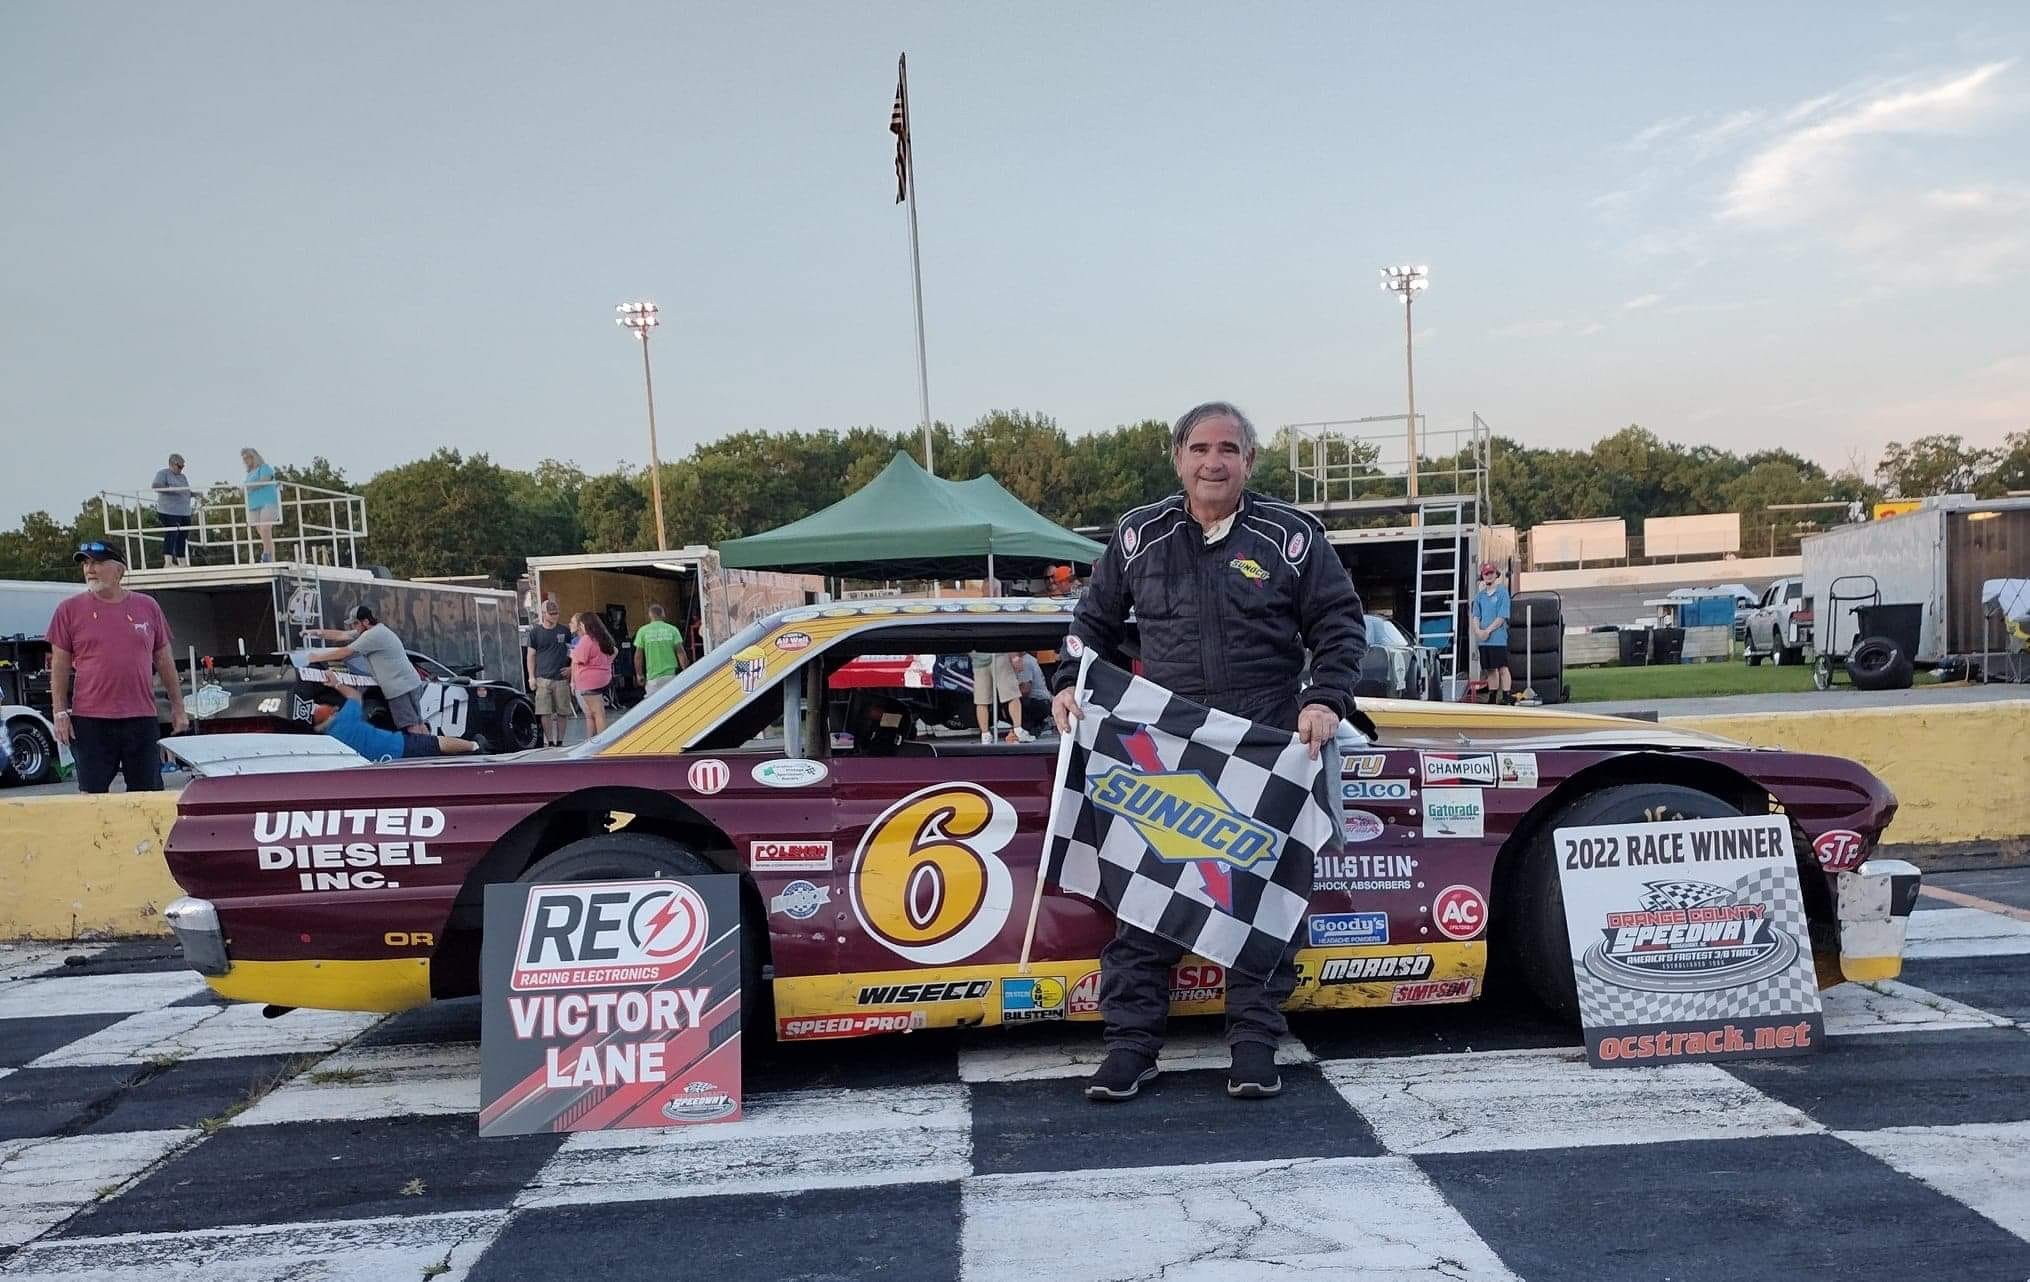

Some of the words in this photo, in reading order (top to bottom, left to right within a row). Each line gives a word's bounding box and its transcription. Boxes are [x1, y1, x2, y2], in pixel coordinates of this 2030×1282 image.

[1231, 559, 1270, 579] SUNOCO
[258, 698, 281, 712] 40
[1428, 763, 1491, 774] CHAMPION
[1343, 782, 1406, 798] elco
[1100, 772, 1268, 862] SUNOCO
[1428, 803, 1480, 817] Gatorade
[254, 807, 445, 843] UNITED
[257, 842, 442, 870] DIESEL
[1565, 837, 1620, 870] 2022
[1626, 833, 1684, 866] RACE
[1691, 827, 1783, 862] WINNER
[1818, 835, 1860, 864] STP
[300, 871, 399, 891] INC.
[849, 781, 1018, 965] 6
[1313, 881, 1348, 891] SHOCK
[1350, 880, 1411, 890] ABSORBERS
[1442, 900, 1478, 924] AC
[1608, 912, 1686, 928] ORANGE
[1688, 905, 1766, 922] COUNTY
[1312, 918, 1385, 936] Goody's
[1613, 919, 1764, 952] SPEEDWAY
[1627, 954, 1674, 964] AMERICA'S
[1674, 951, 1713, 961] FASTEST
[1714, 950, 1729, 959] 3/8
[1731, 949, 1760, 958] TRACK
[520, 970, 570, 986] RACING
[573, 967, 660, 984] ELECTRONICS
[1321, 956, 1433, 980] MOROSO
[858, 980, 992, 1005] WISECO
[1397, 981, 1470, 1001] SIMPSON
[509, 989, 710, 1038] VICTORY
[1004, 1008, 1063, 1020] BILSTEIN
[785, 1015, 912, 1035] SPEED-PRO
[1599, 1022, 1811, 1060] ocstrack.net
[546, 1044, 667, 1088] LANE
[671, 1096, 728, 1109] SPEEDWAY
